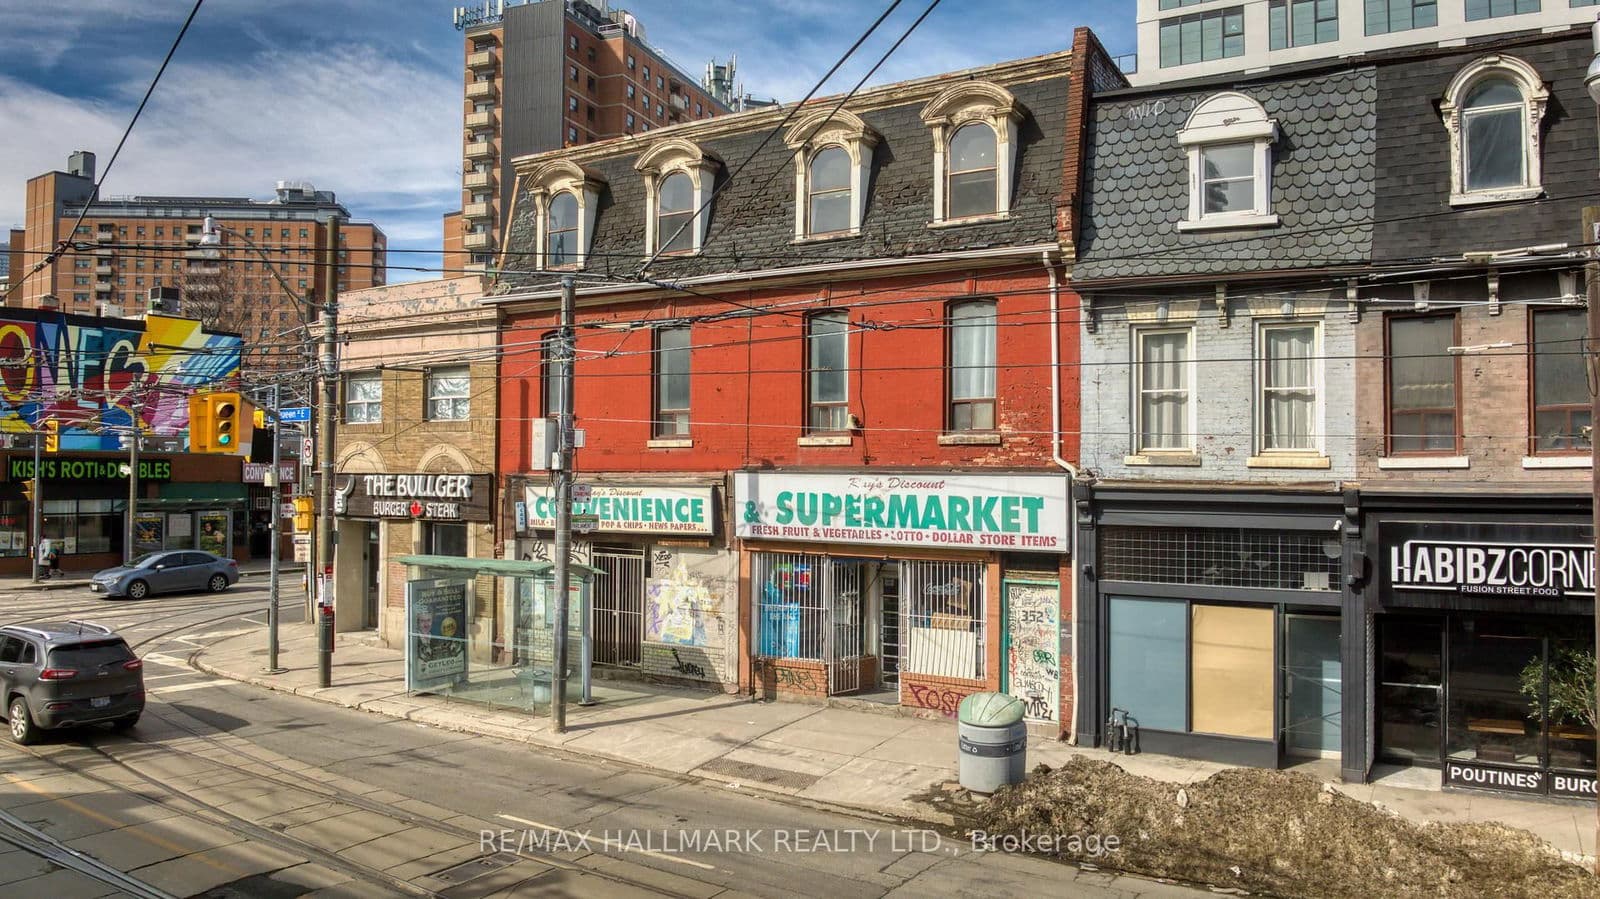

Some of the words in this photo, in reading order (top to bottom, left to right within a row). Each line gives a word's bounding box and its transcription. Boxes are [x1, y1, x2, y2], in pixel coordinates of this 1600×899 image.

[61, 461, 98, 478] ROTI
[363, 475, 396, 496] THE
[397, 475, 472, 498] BULLGER
[888, 476, 945, 490] Discount
[609, 488, 643, 496] Discount
[373, 501, 408, 516] BURGER
[426, 502, 459, 518] STEAK
[744, 500, 761, 523] &
[776, 491, 1044, 533] SUPERMARKET
[601, 521, 615, 529] POP
[648, 522, 668, 530] NEWS
[752, 525, 779, 536] FRESH
[782, 525, 810, 537] FRUIT
[813, 528, 820, 538] &
[823, 528, 882, 540] VEGETABLES
[932, 532, 974, 544] DOLLAR
[980, 534, 1016, 546] STORE
[1021, 535, 1057, 547] ITEMS
[1461, 585, 1494, 593] FUSION
[1496, 586, 1530, 595] STREET
[1532, 587, 1558, 596] FOOD
[1021, 610, 1045, 623] 352
[1451, 766, 1537, 788] POUTINES
